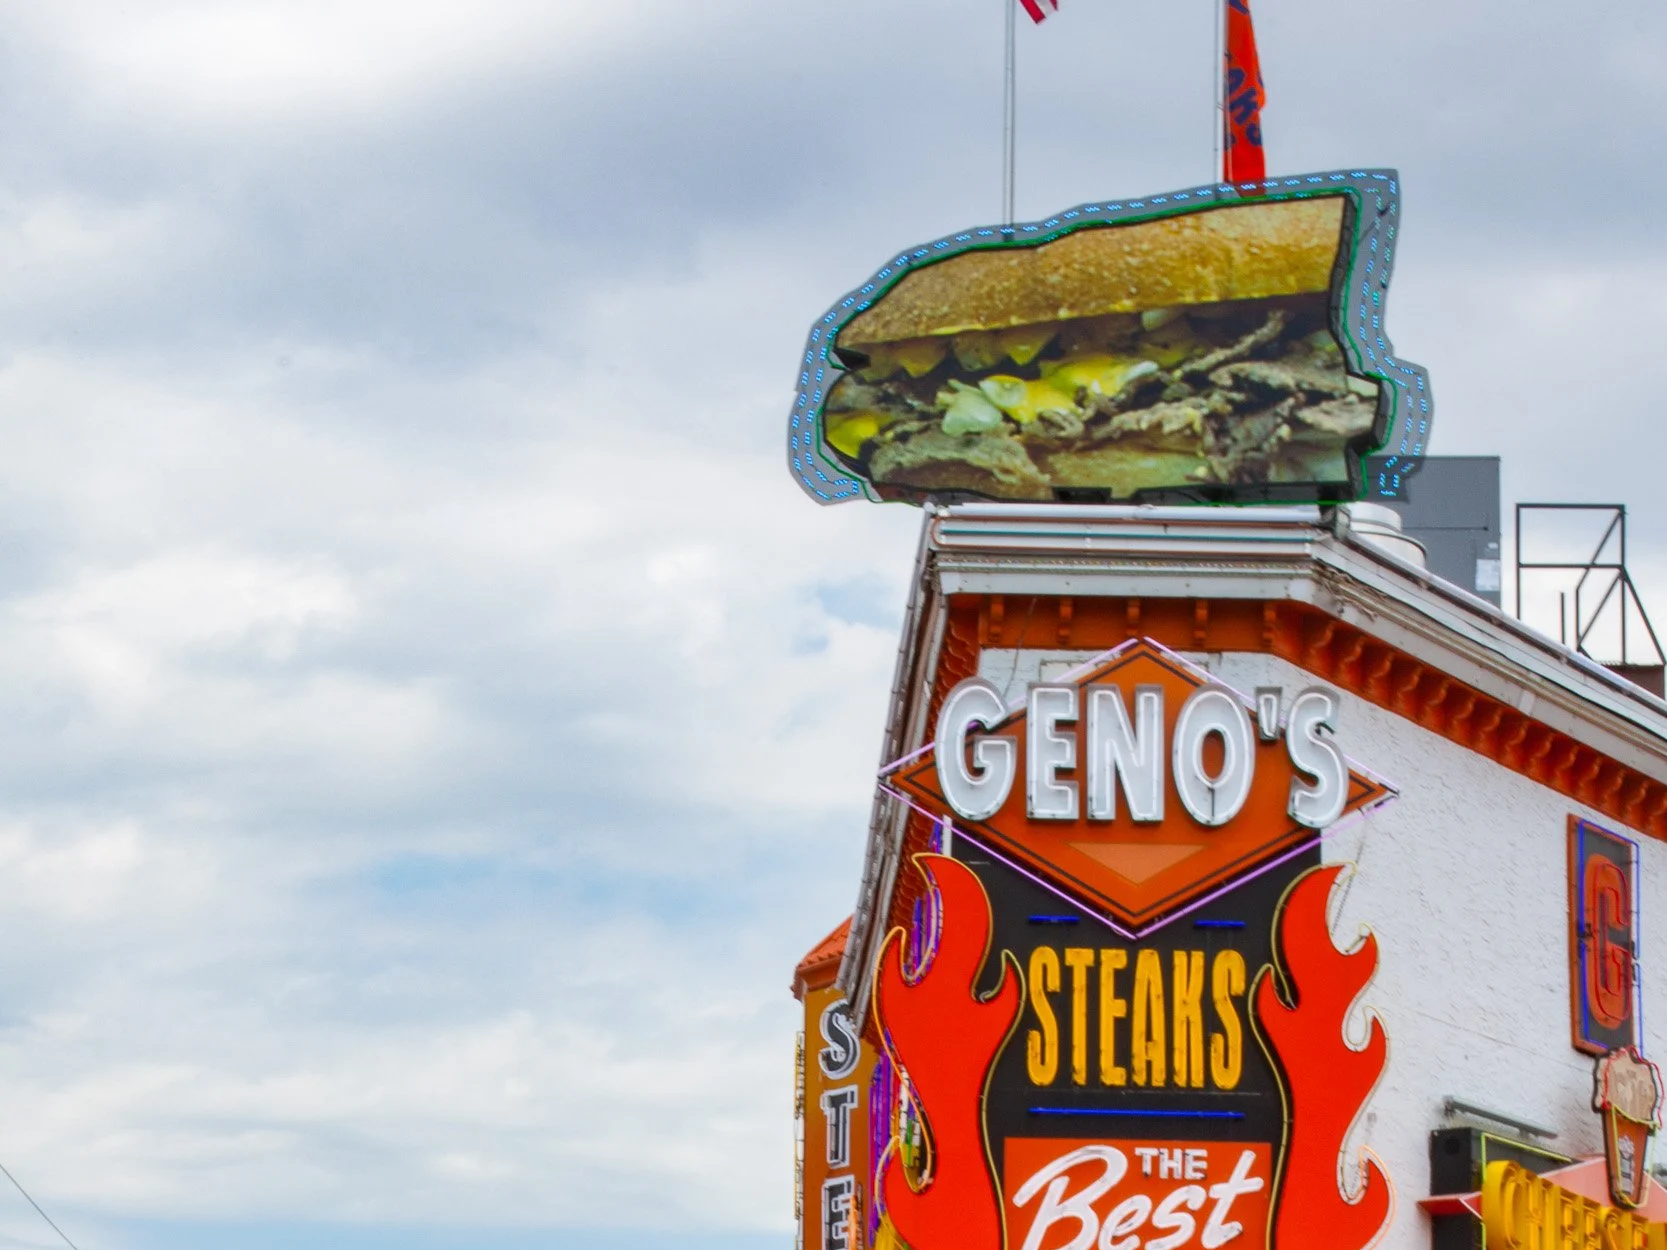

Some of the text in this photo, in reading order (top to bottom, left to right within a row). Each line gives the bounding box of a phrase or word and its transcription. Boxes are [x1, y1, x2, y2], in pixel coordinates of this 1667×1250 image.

[934, 677, 1349, 828] GENO'S
[1026, 945, 1247, 1090] STEAKS
[1134, 1147, 1208, 1180] THE
